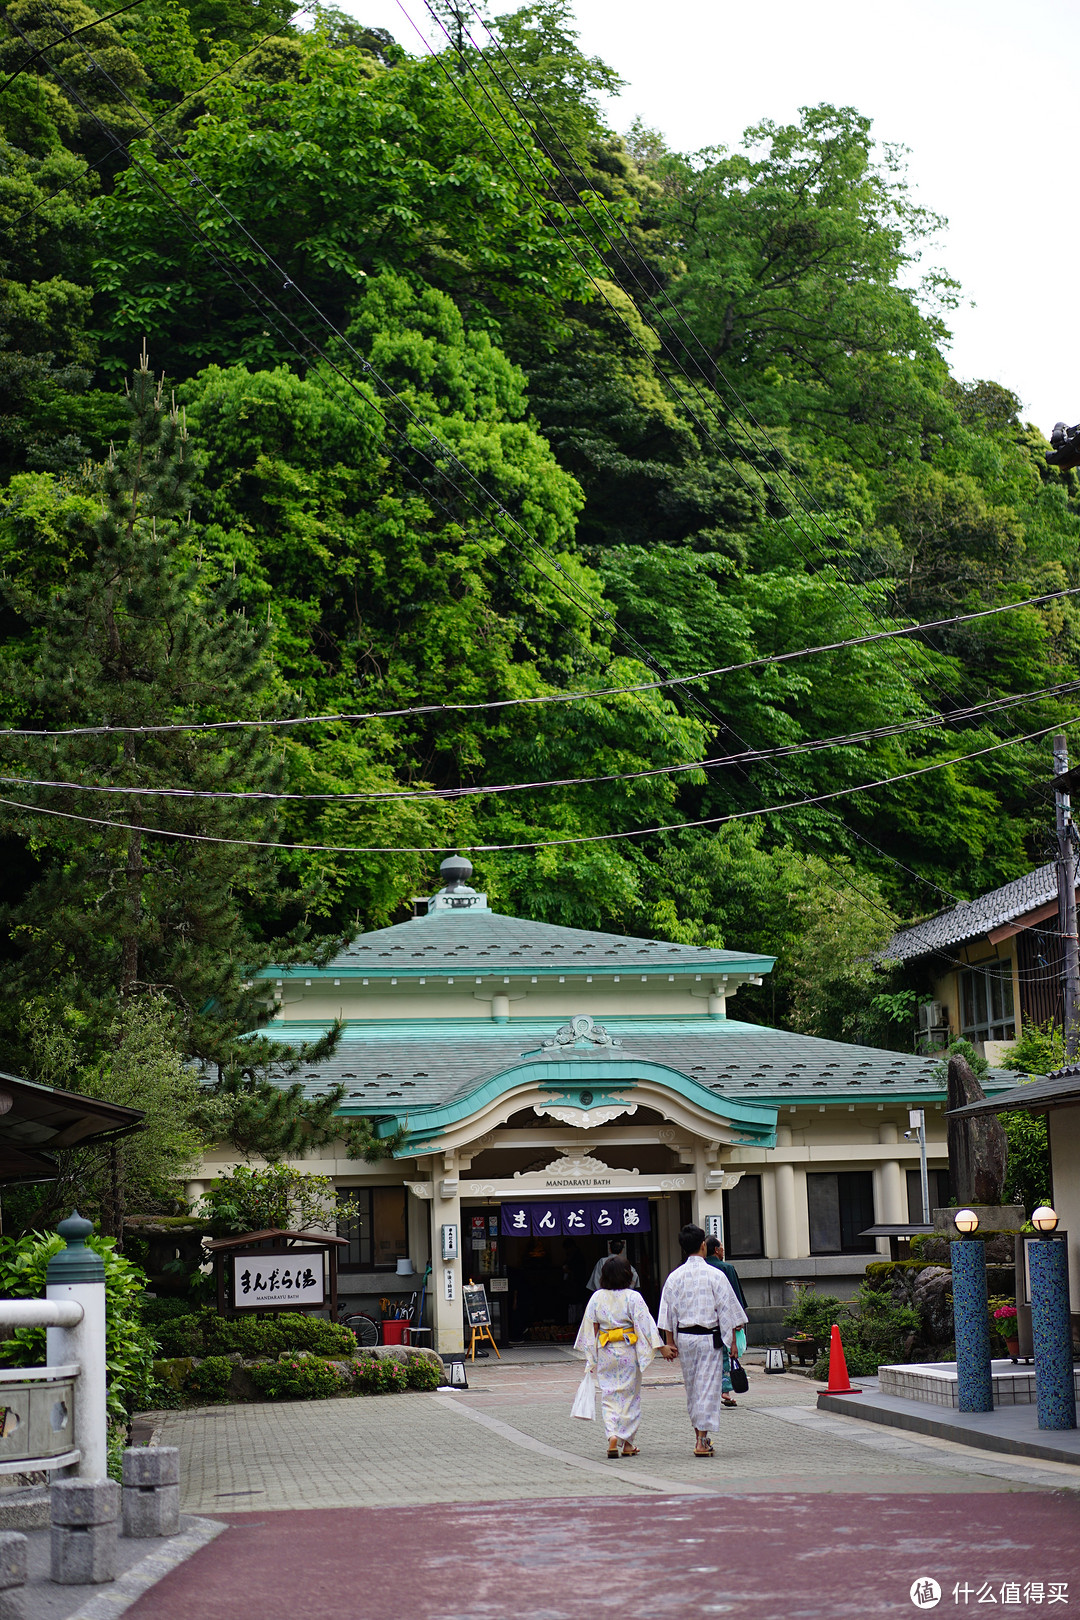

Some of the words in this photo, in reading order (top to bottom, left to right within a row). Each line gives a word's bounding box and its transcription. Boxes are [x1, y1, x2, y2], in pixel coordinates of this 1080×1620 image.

[546, 1179, 591, 1187] MANDARAYU
[512, 1208, 640, 1229] まんだら湯
[240, 1268, 317, 1294] まんだら湯
